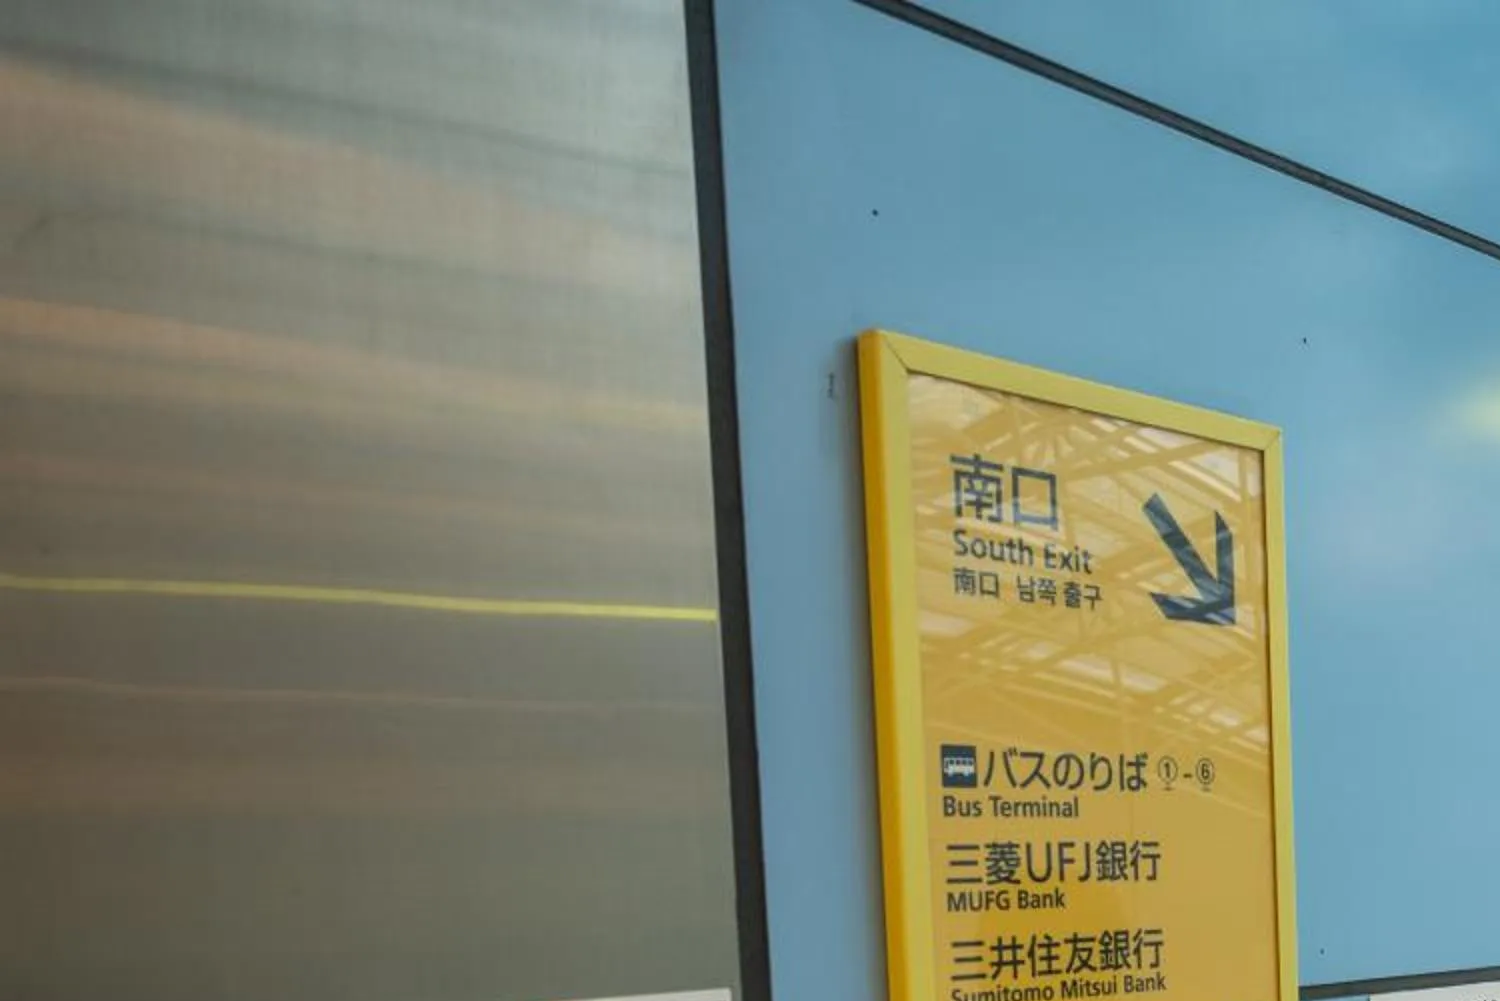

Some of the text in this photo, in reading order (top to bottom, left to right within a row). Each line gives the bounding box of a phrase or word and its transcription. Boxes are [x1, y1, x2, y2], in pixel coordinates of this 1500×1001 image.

[950, 453, 1058, 531] 南口
[953, 529, 1092, 574] South Exit
[953, 567, 1000, 598] 南口
[983, 747, 1149, 792] バスのりば
[942, 795, 1079, 818] Bus Terminal
[946, 840, 1161, 885] 三菱UFJ銀行
[946, 888, 1065, 912] MUFG Bank
[950, 928, 1165, 981] 三井住友銀行
[1060, 975, 1117, 1000] Mitsui
[1124, 971, 1167, 994] Bank
